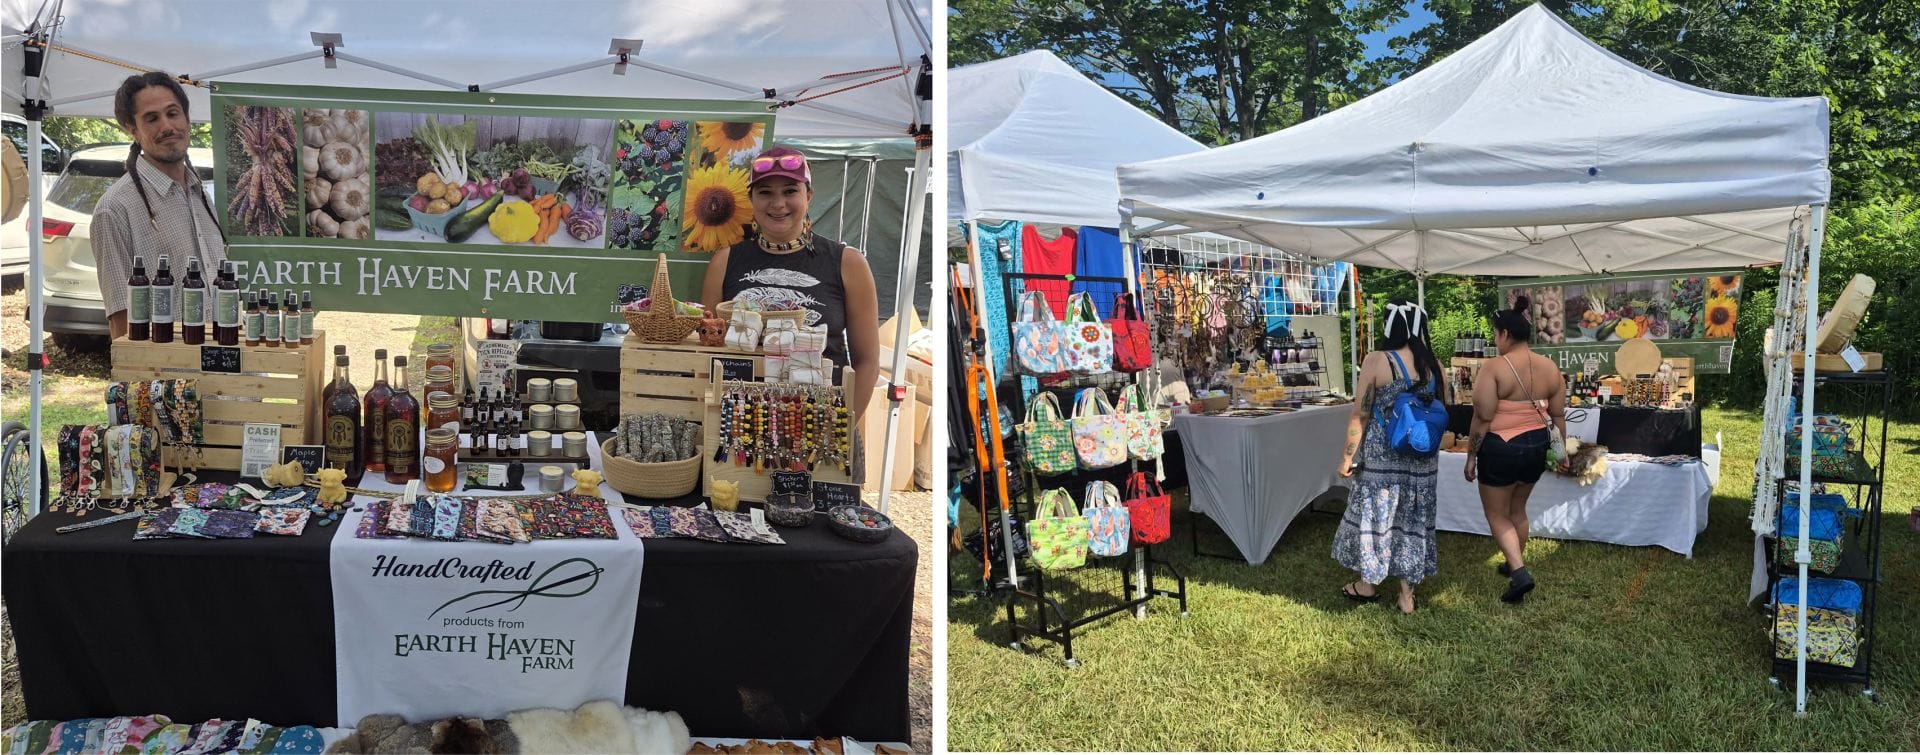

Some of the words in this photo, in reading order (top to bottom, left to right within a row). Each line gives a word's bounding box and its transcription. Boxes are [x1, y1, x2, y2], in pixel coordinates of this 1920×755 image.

[231, 260, 342, 293] EARTH
[357, 257, 471, 295] HAVEN
[483, 268, 578, 300] FARM
[1558, 350, 1609, 369] HAVEN
[247, 426, 277, 436] CASH
[290, 448, 317, 458] Maple
[816, 482, 843, 492] Stone
[827, 492, 855, 502] Hearts
[372, 555, 536, 584] HandCrafted
[443, 616, 494, 628] products
[498, 617, 525, 629] from
[394, 634, 477, 657] EARTH
[486, 632, 576, 660] HAVEN
[521, 656, 575, 673] FARM
